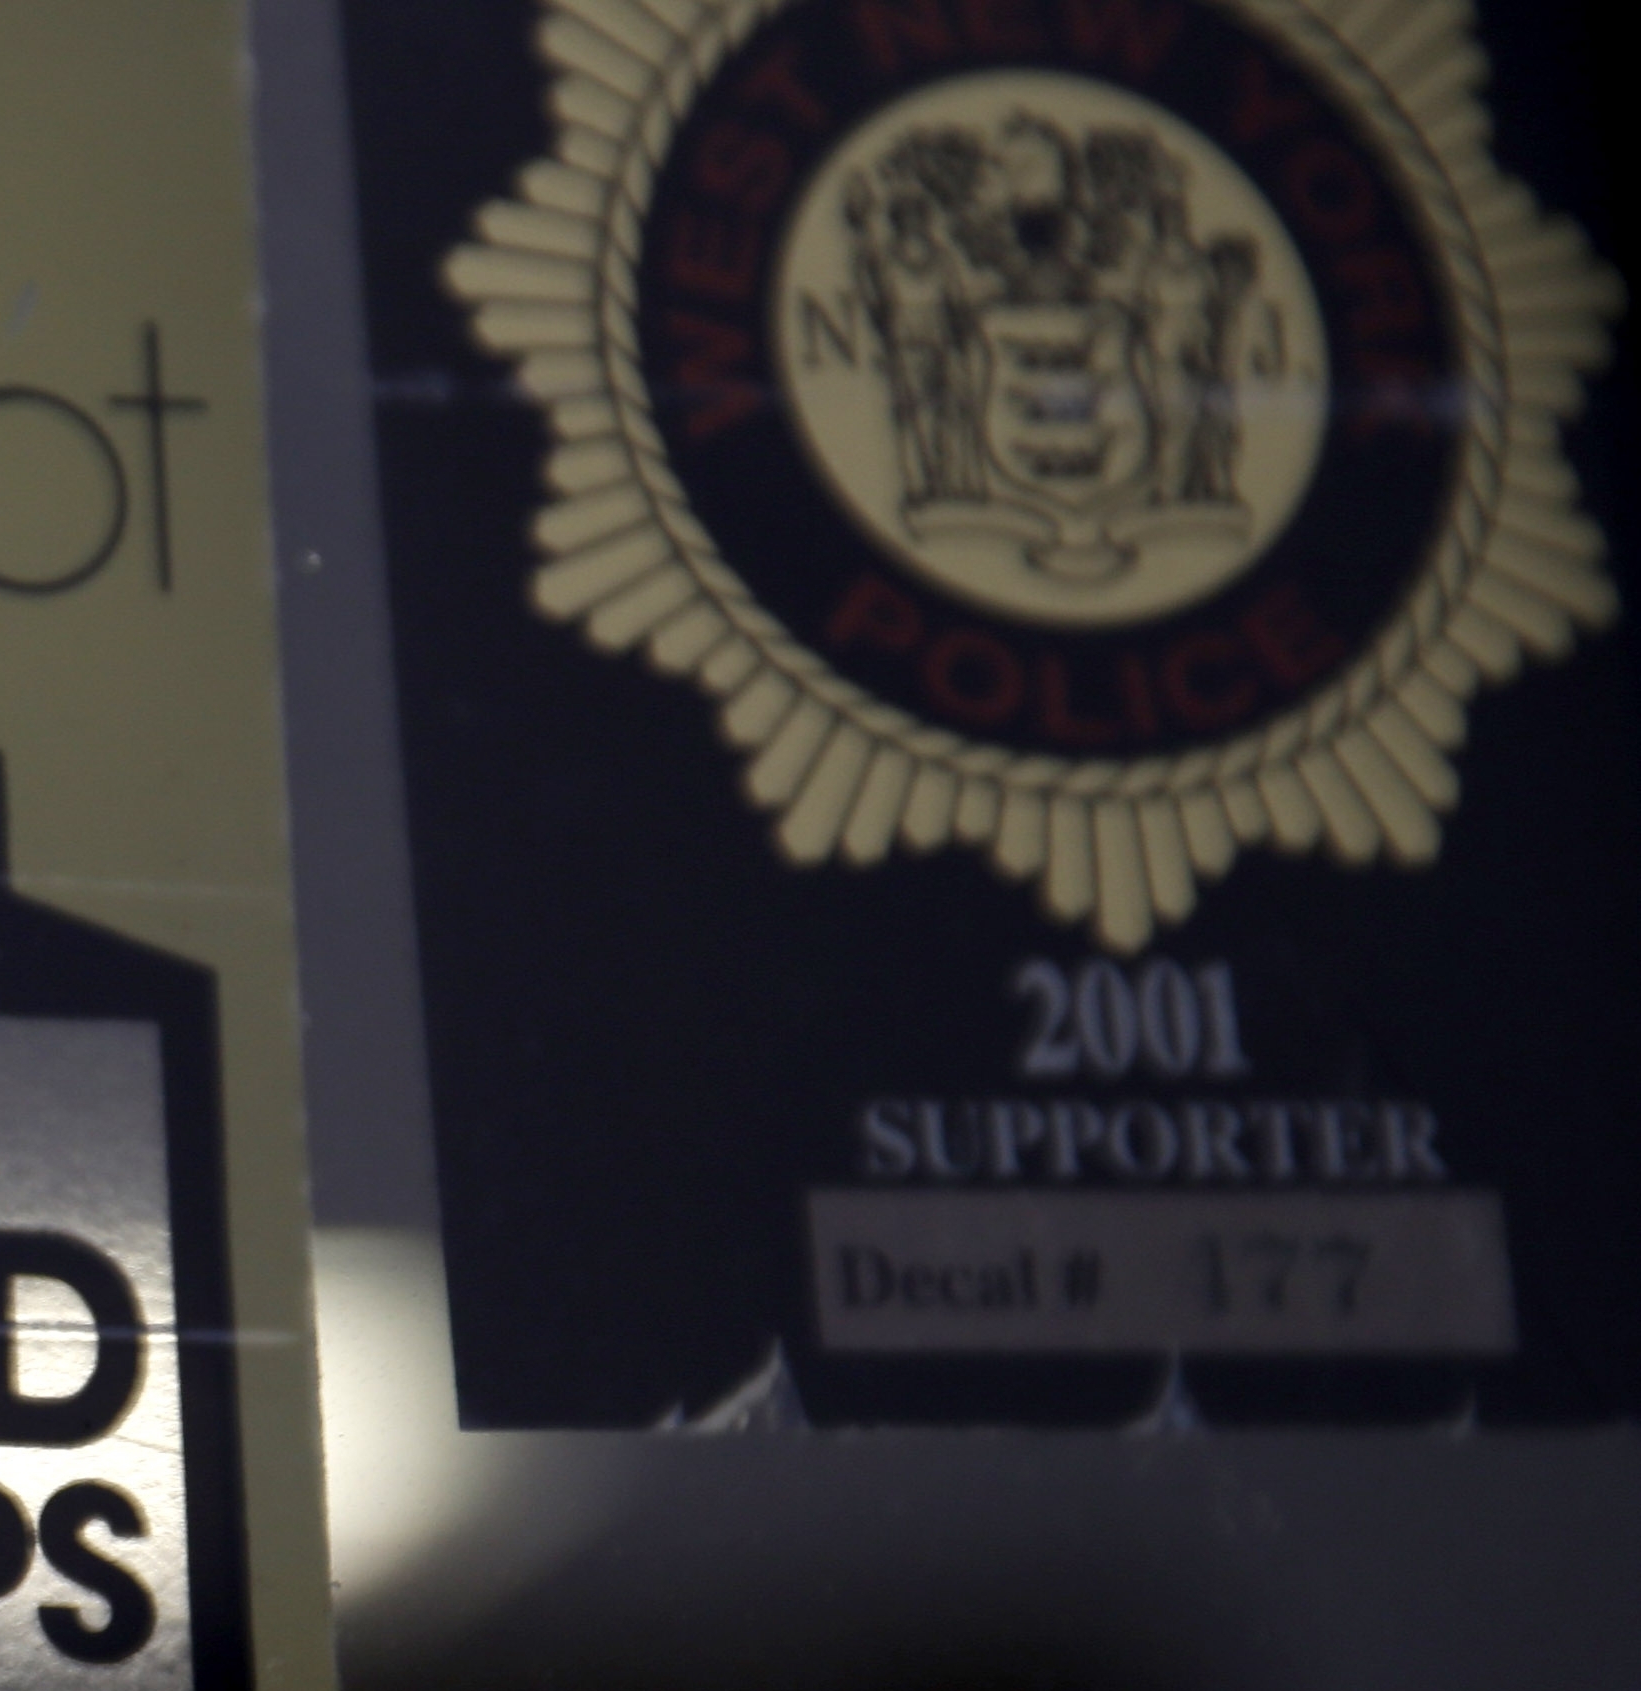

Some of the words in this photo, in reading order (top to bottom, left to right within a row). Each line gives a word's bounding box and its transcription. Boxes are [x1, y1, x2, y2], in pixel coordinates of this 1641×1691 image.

[666, 46, 827, 438] WEST
[1229, 50, 1435, 440] YORK
[827, 572, 1347, 745] POLICE
[1015, 958, 1249, 1077] 2001
[862, 1098, 1450, 1180] SUPPORTER
[835, 1243, 1039, 1312] Decal
[1197, 1230, 1372, 1317] 177
